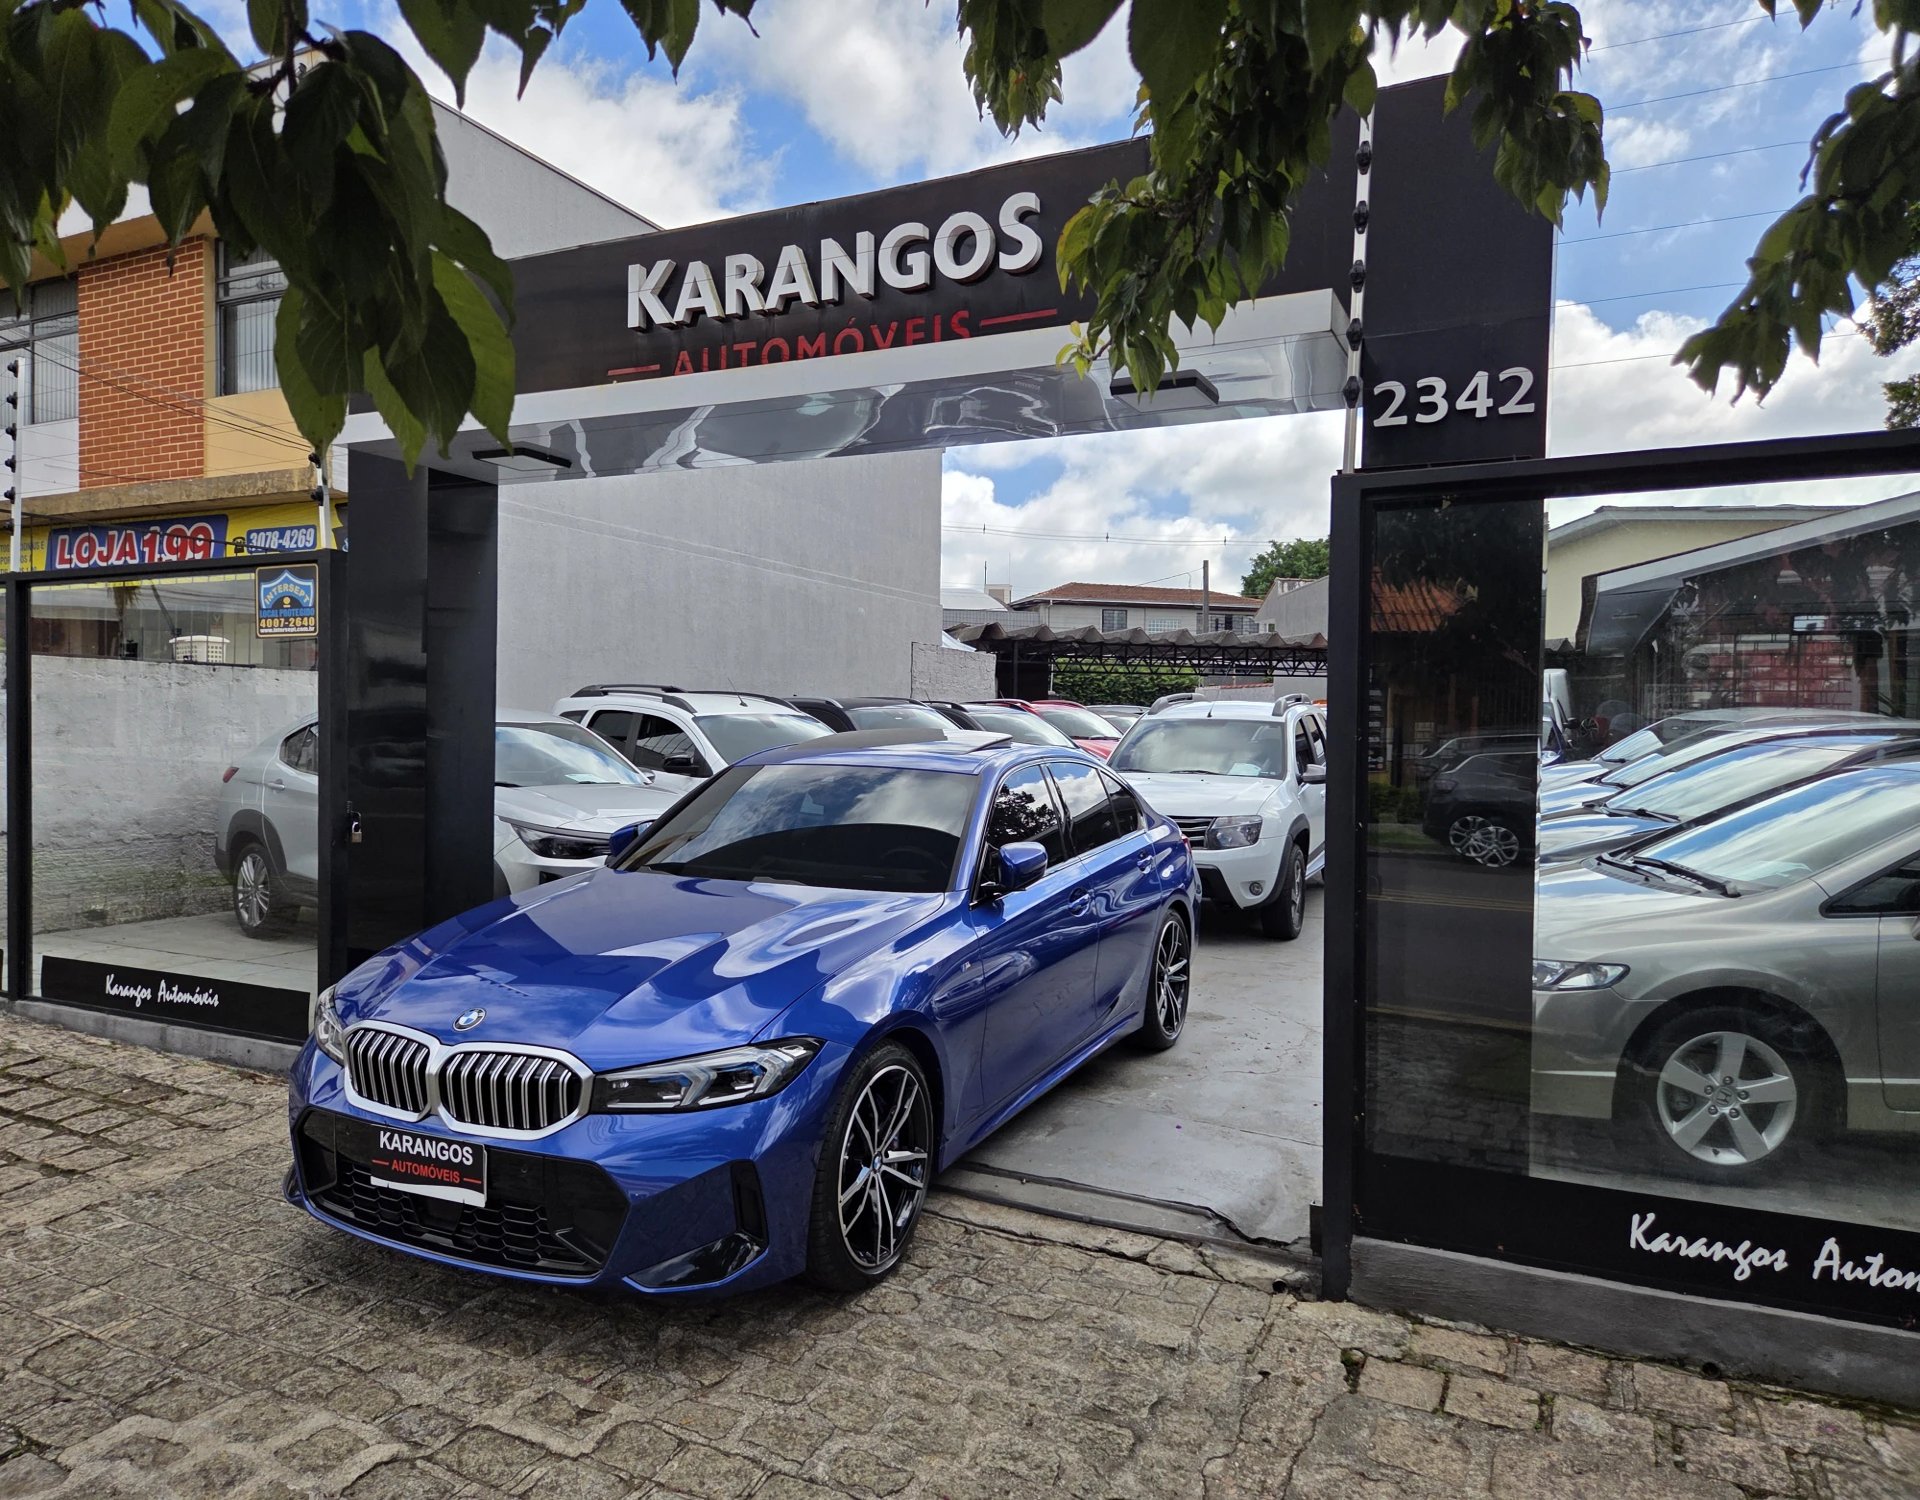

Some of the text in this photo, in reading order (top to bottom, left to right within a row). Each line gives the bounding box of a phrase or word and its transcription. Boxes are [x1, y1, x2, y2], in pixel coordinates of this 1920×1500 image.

[627, 191, 1043, 332] KARANGOS
[1372, 366, 1537, 428] 2342
[56, 529, 140, 569] LOJA
[249, 528, 316, 551] 3078-4269
[264, 583, 310, 605] INTERSEPT
[260, 616, 315, 628] 4007-2640
[105, 973, 152, 1008] Karangos
[379, 1130, 473, 1166] KARANGOS
[391, 1159, 461, 1184] AUTOMÓVEIS
[1629, 1212, 1789, 1281] Karangos
